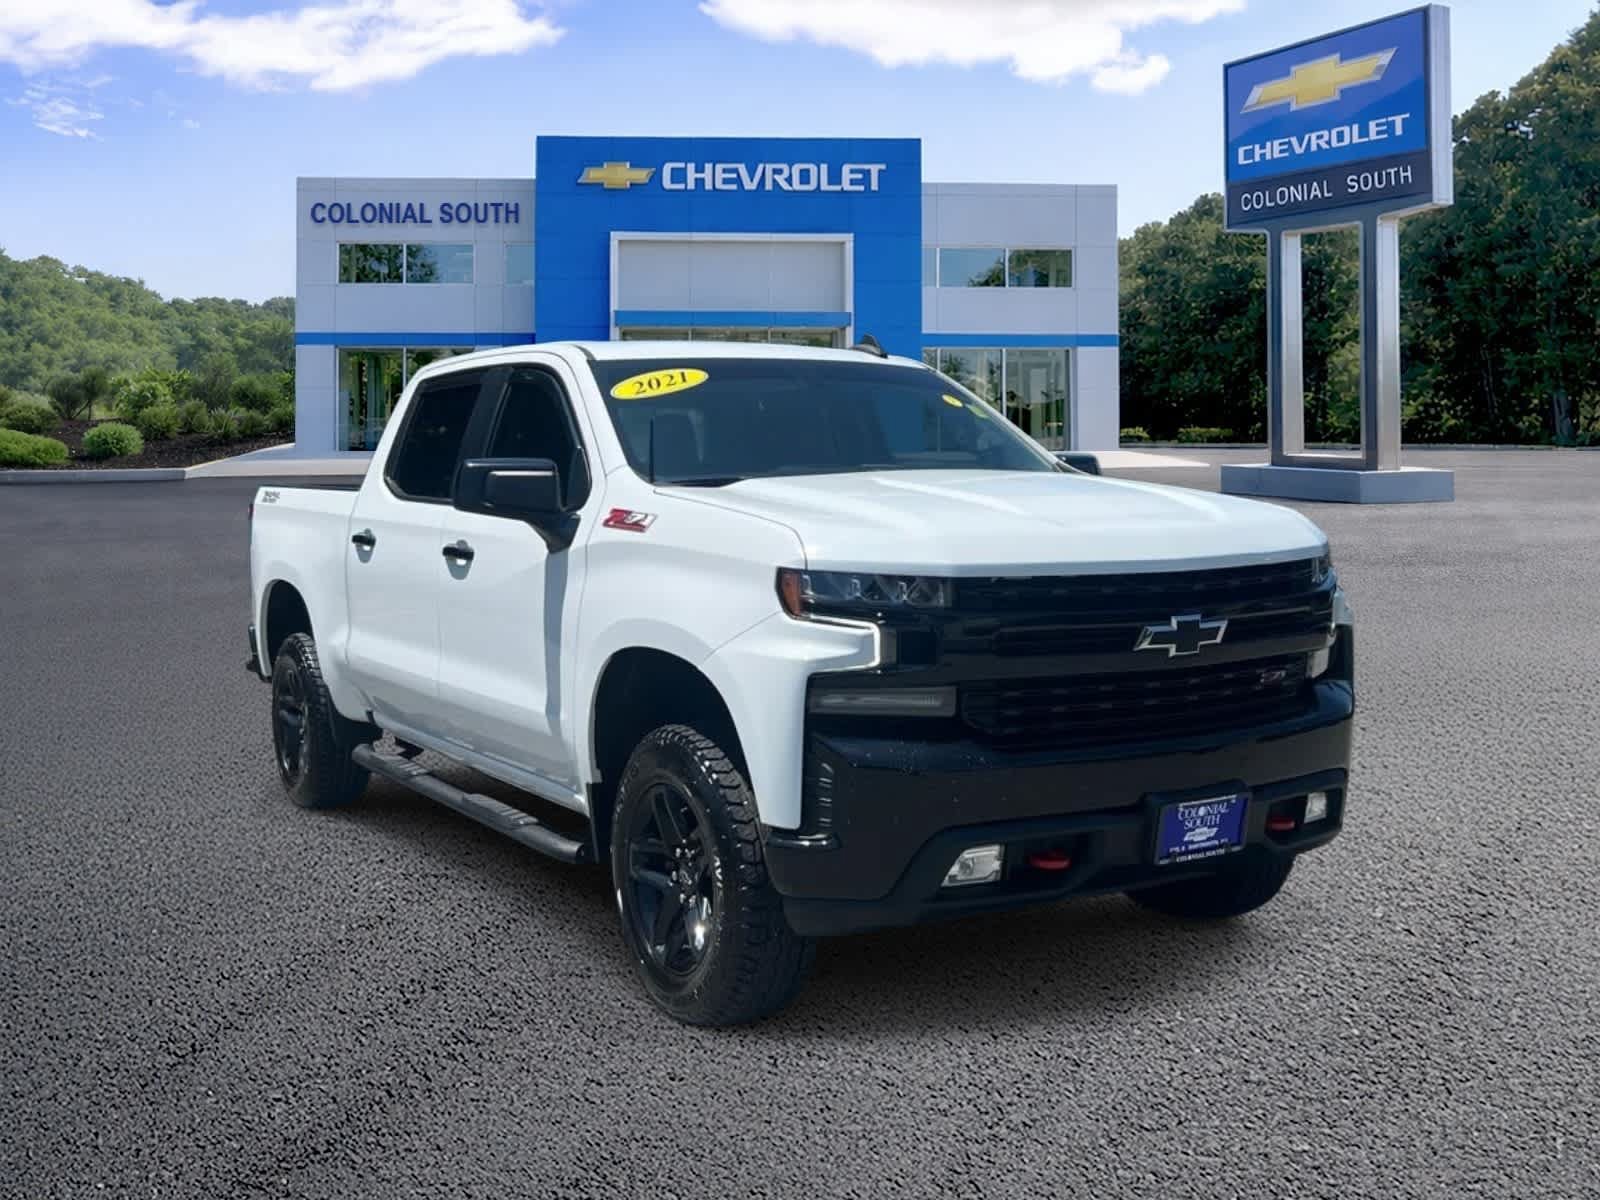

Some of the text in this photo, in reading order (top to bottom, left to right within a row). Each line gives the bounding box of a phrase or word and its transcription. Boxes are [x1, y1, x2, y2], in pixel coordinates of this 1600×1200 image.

[1237, 113, 1410, 165] CHEVROLET
[661, 162, 887, 192] CHEVROLET
[1240, 165, 1413, 212] COLONIAL SOUTH
[310, 201, 521, 225] COLONIAL SOUTH
[632, 371, 687, 395] 2021
[602, 508, 658, 533] Z71
[1178, 802, 1230, 821] COLONIAL
[1184, 814, 1221, 830] SOUTH
